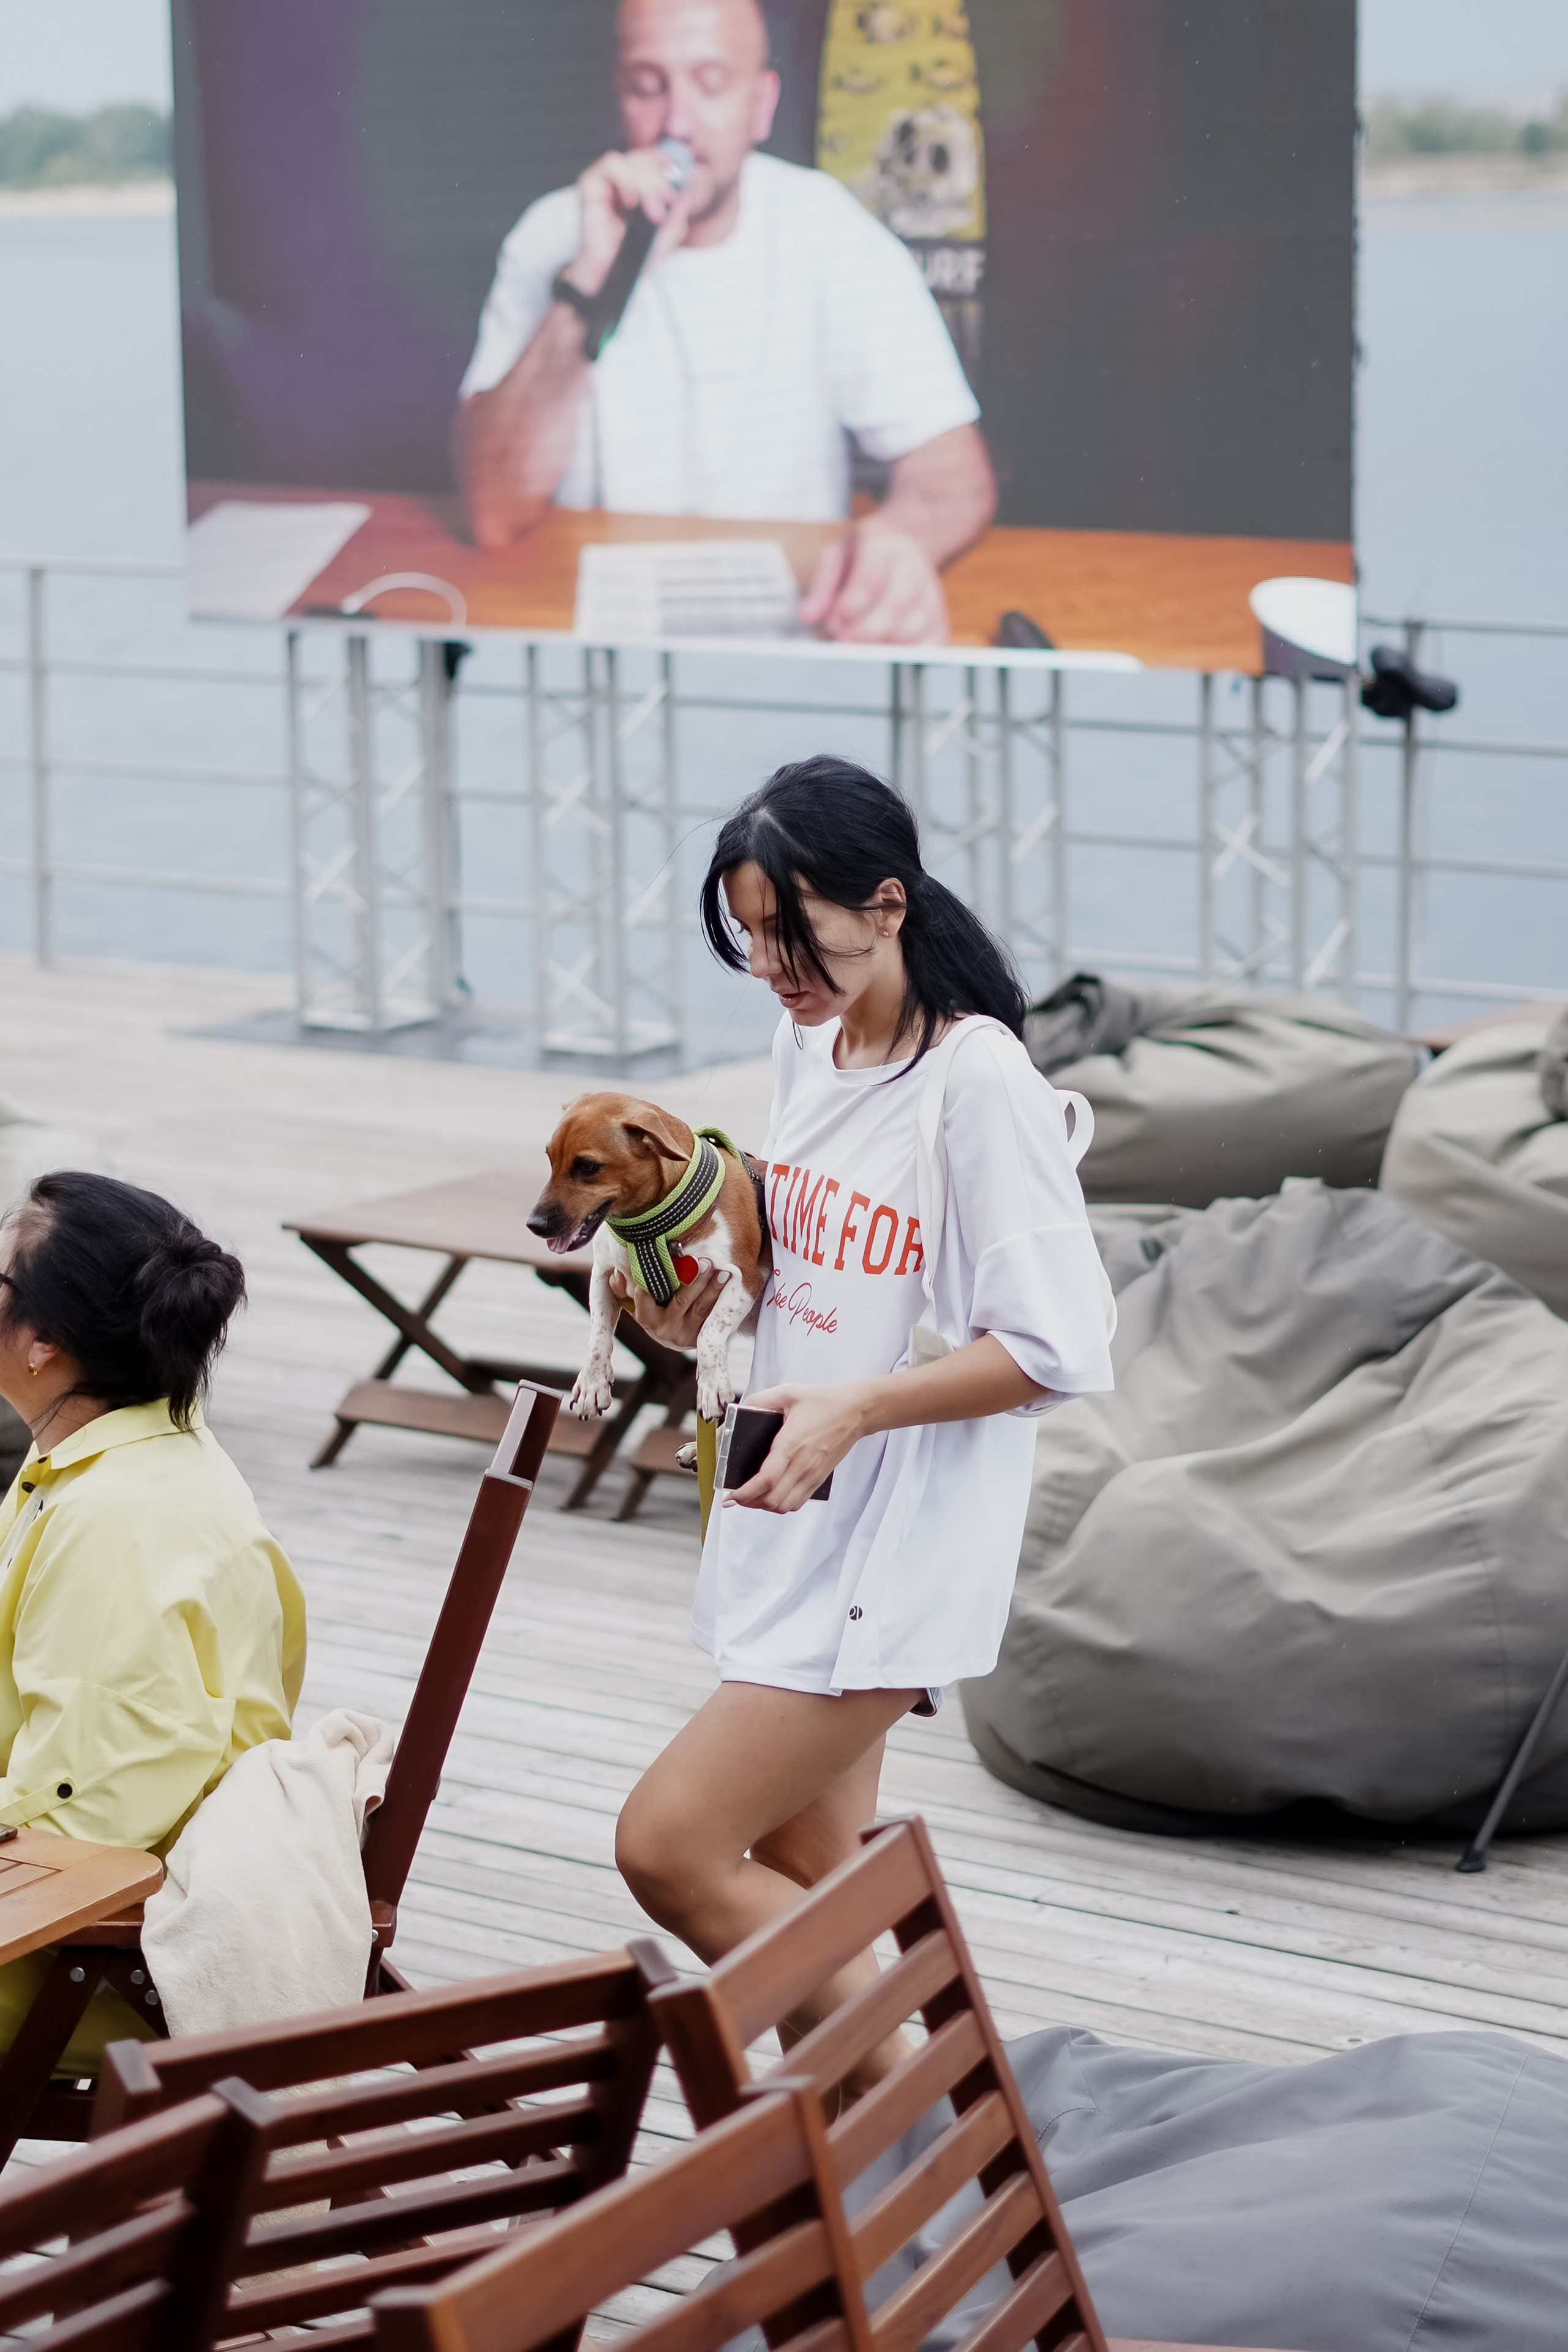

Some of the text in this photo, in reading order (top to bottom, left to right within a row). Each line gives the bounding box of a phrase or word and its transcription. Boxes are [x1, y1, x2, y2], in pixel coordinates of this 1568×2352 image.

[771, 1163, 925, 1275] TIME FOR
[788, 1282, 838, 1336] People
